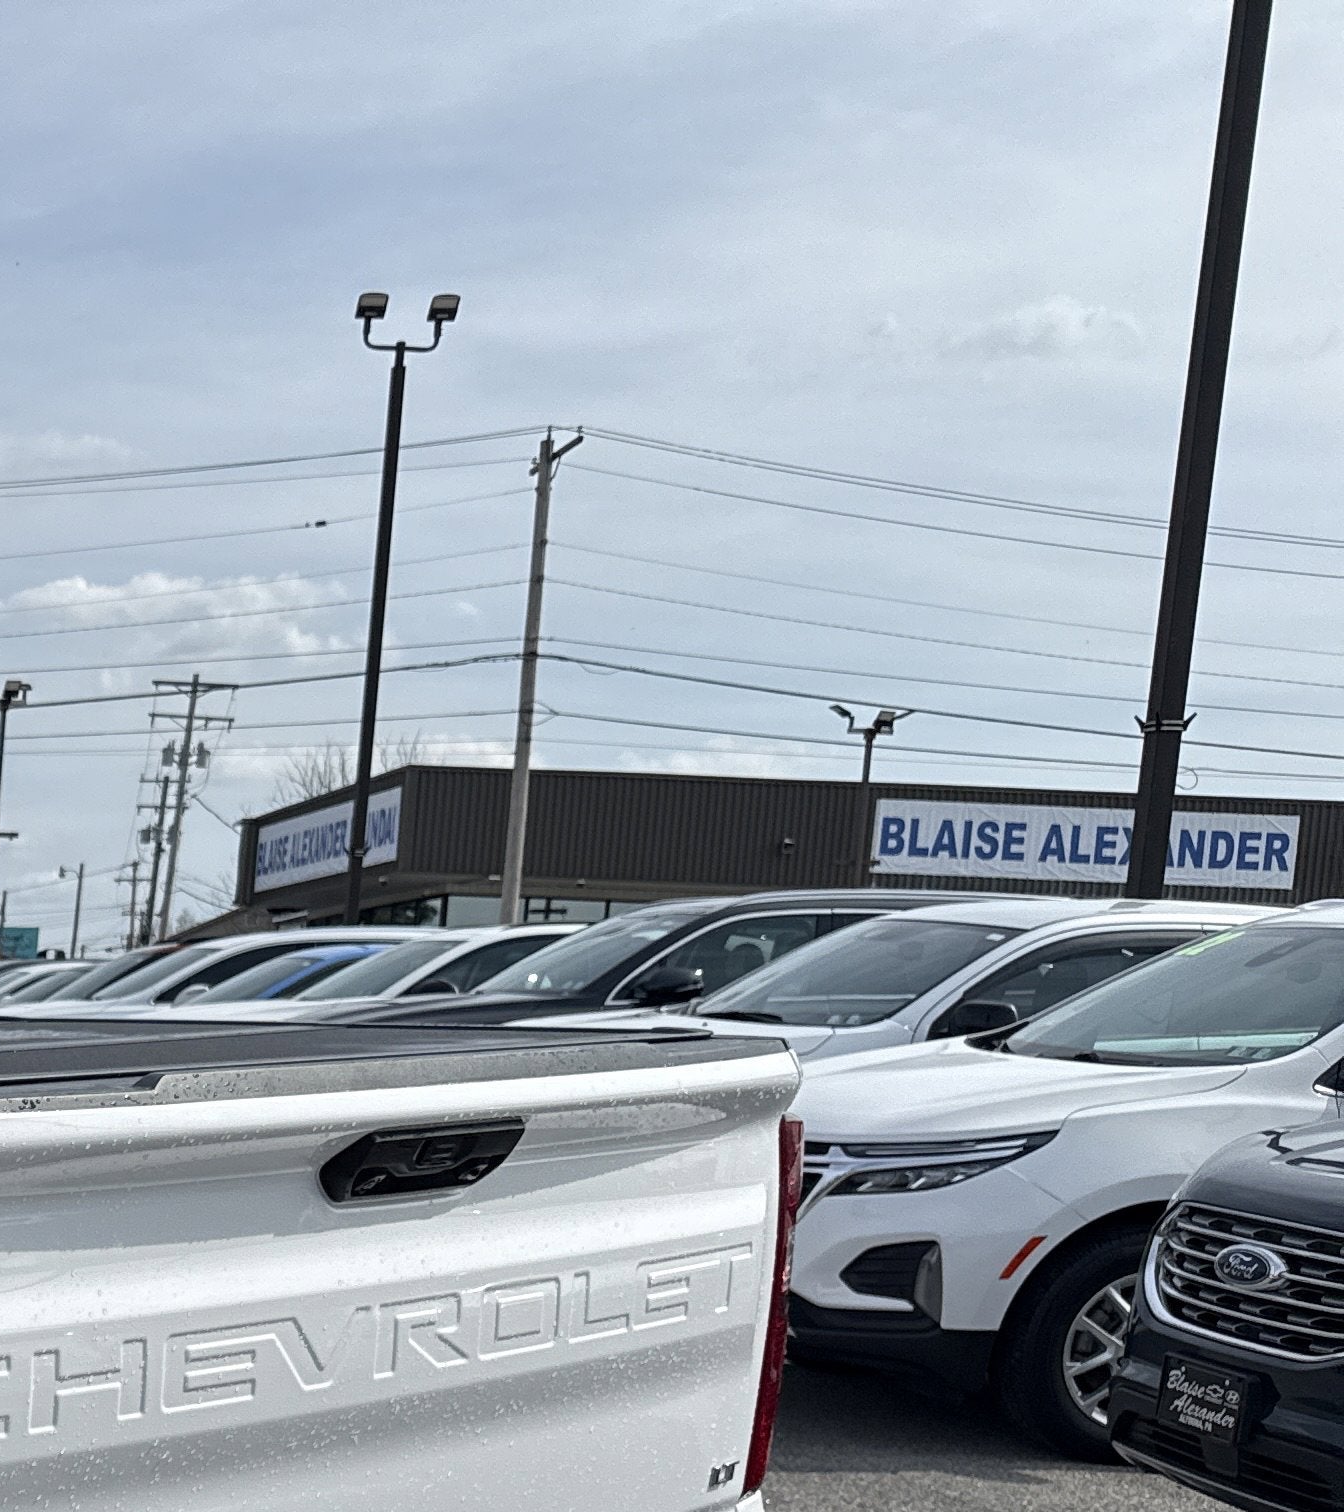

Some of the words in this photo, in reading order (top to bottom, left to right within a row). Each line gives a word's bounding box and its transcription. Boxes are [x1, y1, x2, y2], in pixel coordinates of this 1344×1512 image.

[257, 835, 289, 876] BLAISE
[289, 820, 348, 868] ALEXANDER
[878, 816, 1027, 860] BLAISE
[1038, 822, 1291, 872] ALENDER
[1223, 1252, 1259, 1280] Ford
[1167, 1369, 1205, 1398] Blaise
[1169, 1394, 1235, 1429] Alexander
[708, 1460, 740, 1488] LT
